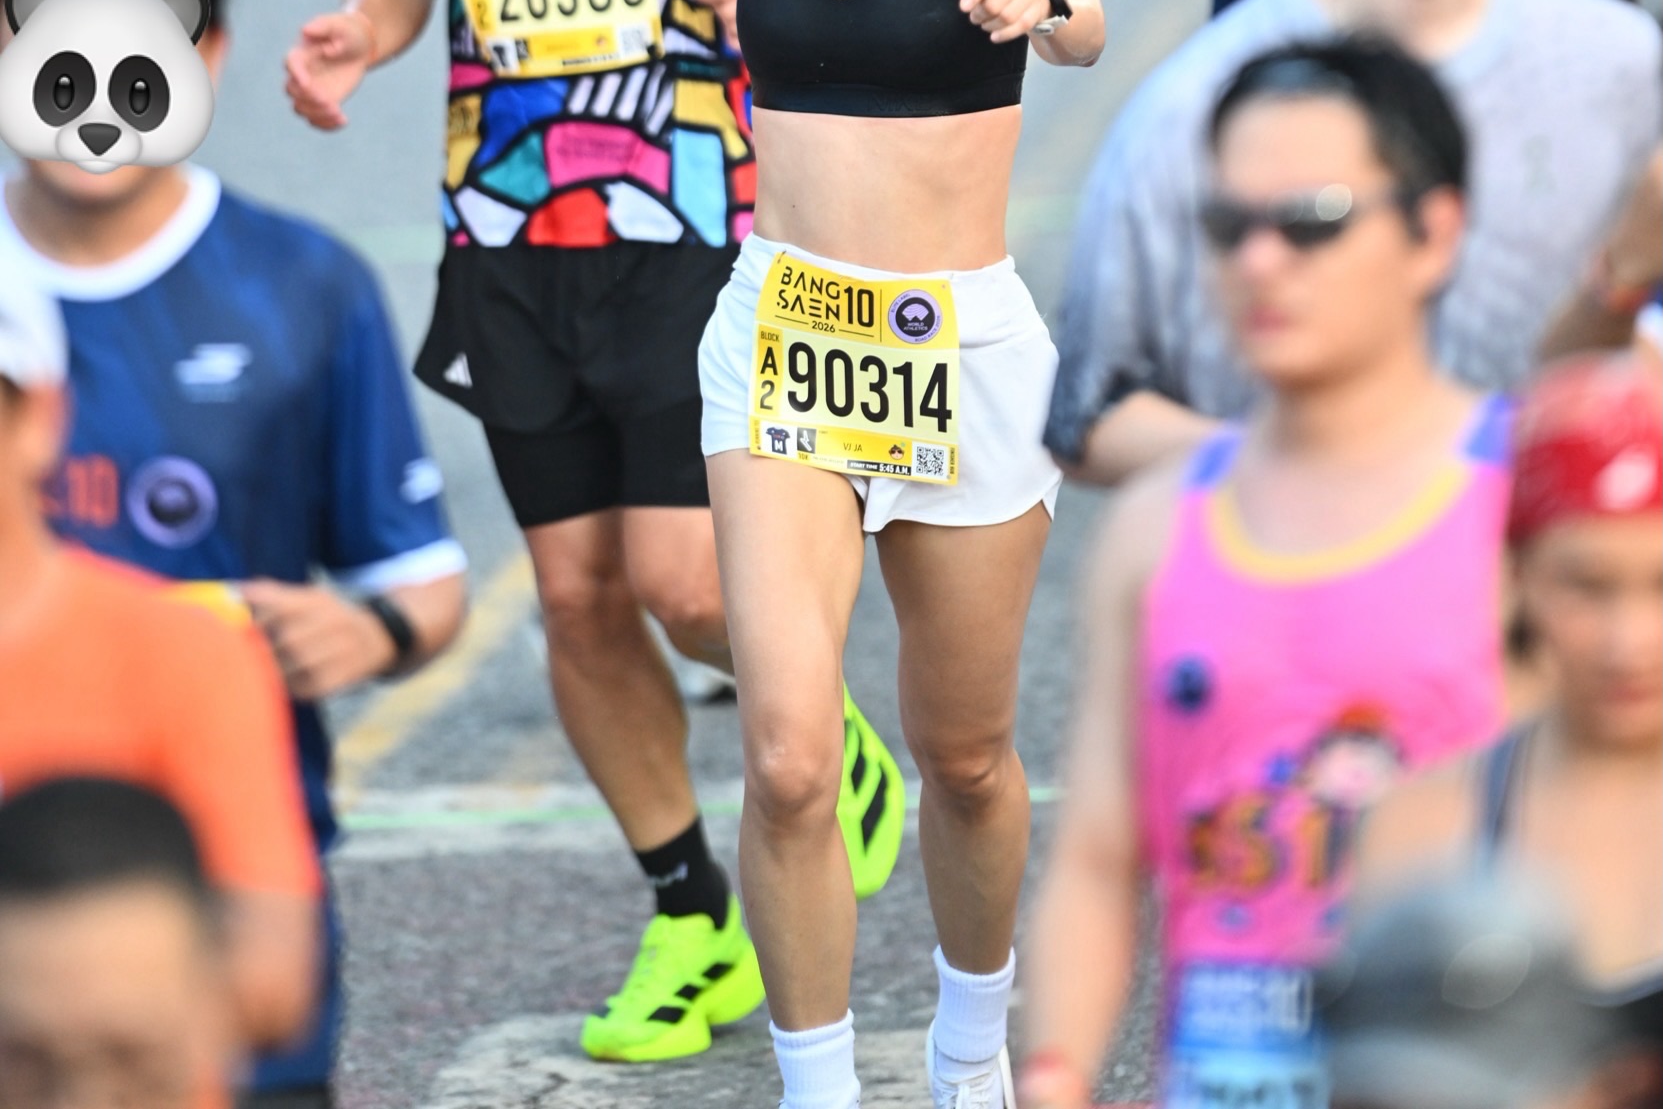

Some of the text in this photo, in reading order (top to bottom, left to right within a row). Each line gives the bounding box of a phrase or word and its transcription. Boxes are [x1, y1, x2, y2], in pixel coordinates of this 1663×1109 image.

[781, 266, 841, 300] BANG
[776, 289, 841, 322] SAEN
[844, 285, 875, 328] 10
[761, 330, 780, 342] BLOCK
[811, 321, 836, 333] 2026
[760, 346, 778, 376] A
[759, 380, 775, 410] 2
[787, 341, 953, 433] 90314
[774, 439, 784, 452] M
[879, 463, 894, 473] 5:45
[895, 465, 910, 475] A.M.
